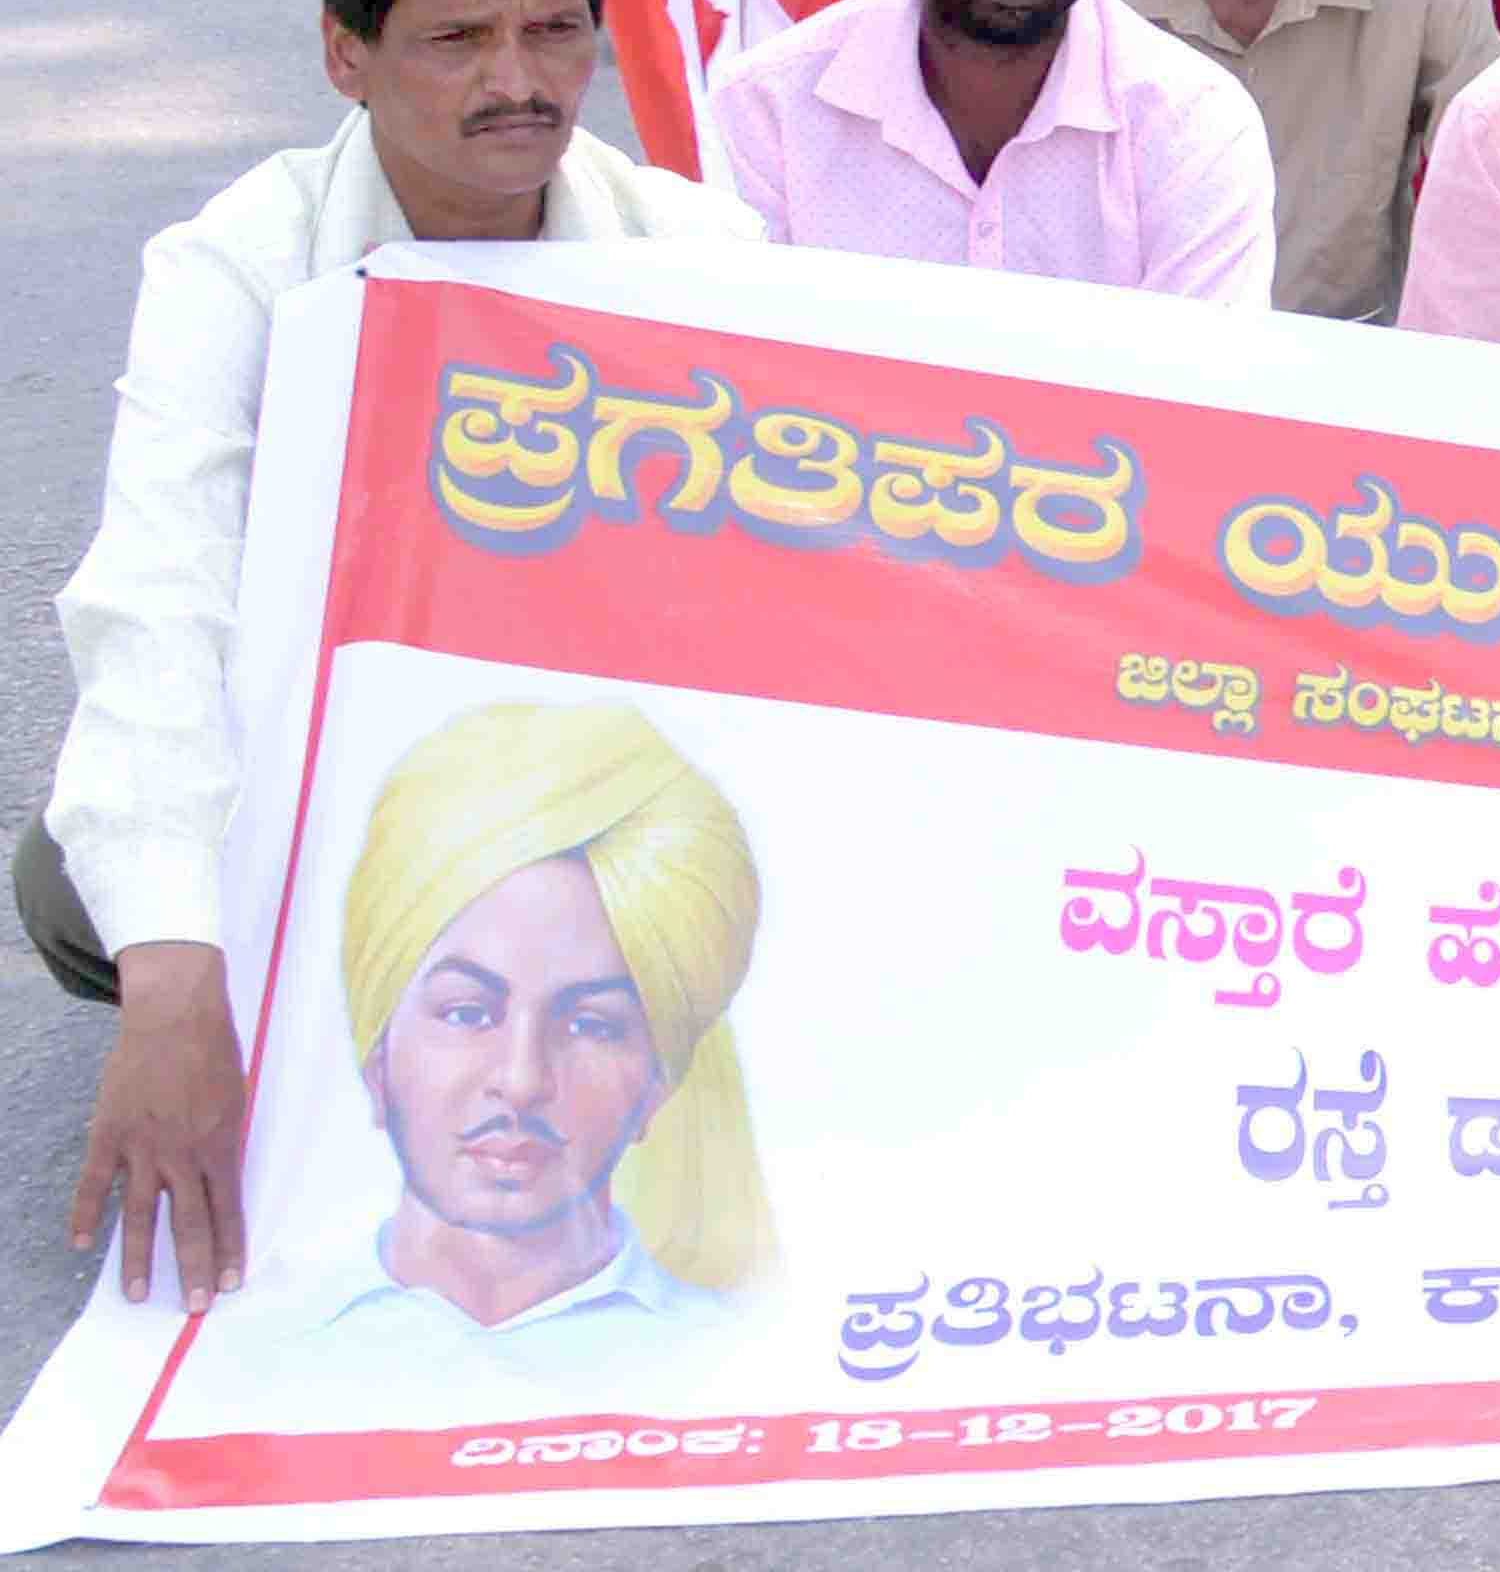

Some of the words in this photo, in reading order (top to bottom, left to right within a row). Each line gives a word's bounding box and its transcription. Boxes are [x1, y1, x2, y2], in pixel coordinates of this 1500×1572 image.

[433, 342, 1140, 573] ಪ್ರಗತಿಪರ
[1117, 650, 1262, 733] ಜಿಲ್ಲಾ
[1059, 843, 1368, 1010] ವಸ್ತಾರೆ
[1236, 1046, 1390, 1211] ರಸ್ತೆ
[836, 1266, 1360, 1382] ಪ್ರತಿಭಟನಾ,
[450, 1423, 766, 1470] ದಿನಾಂಕ:
[804, 1396, 1318, 1455] 18-12-2017
